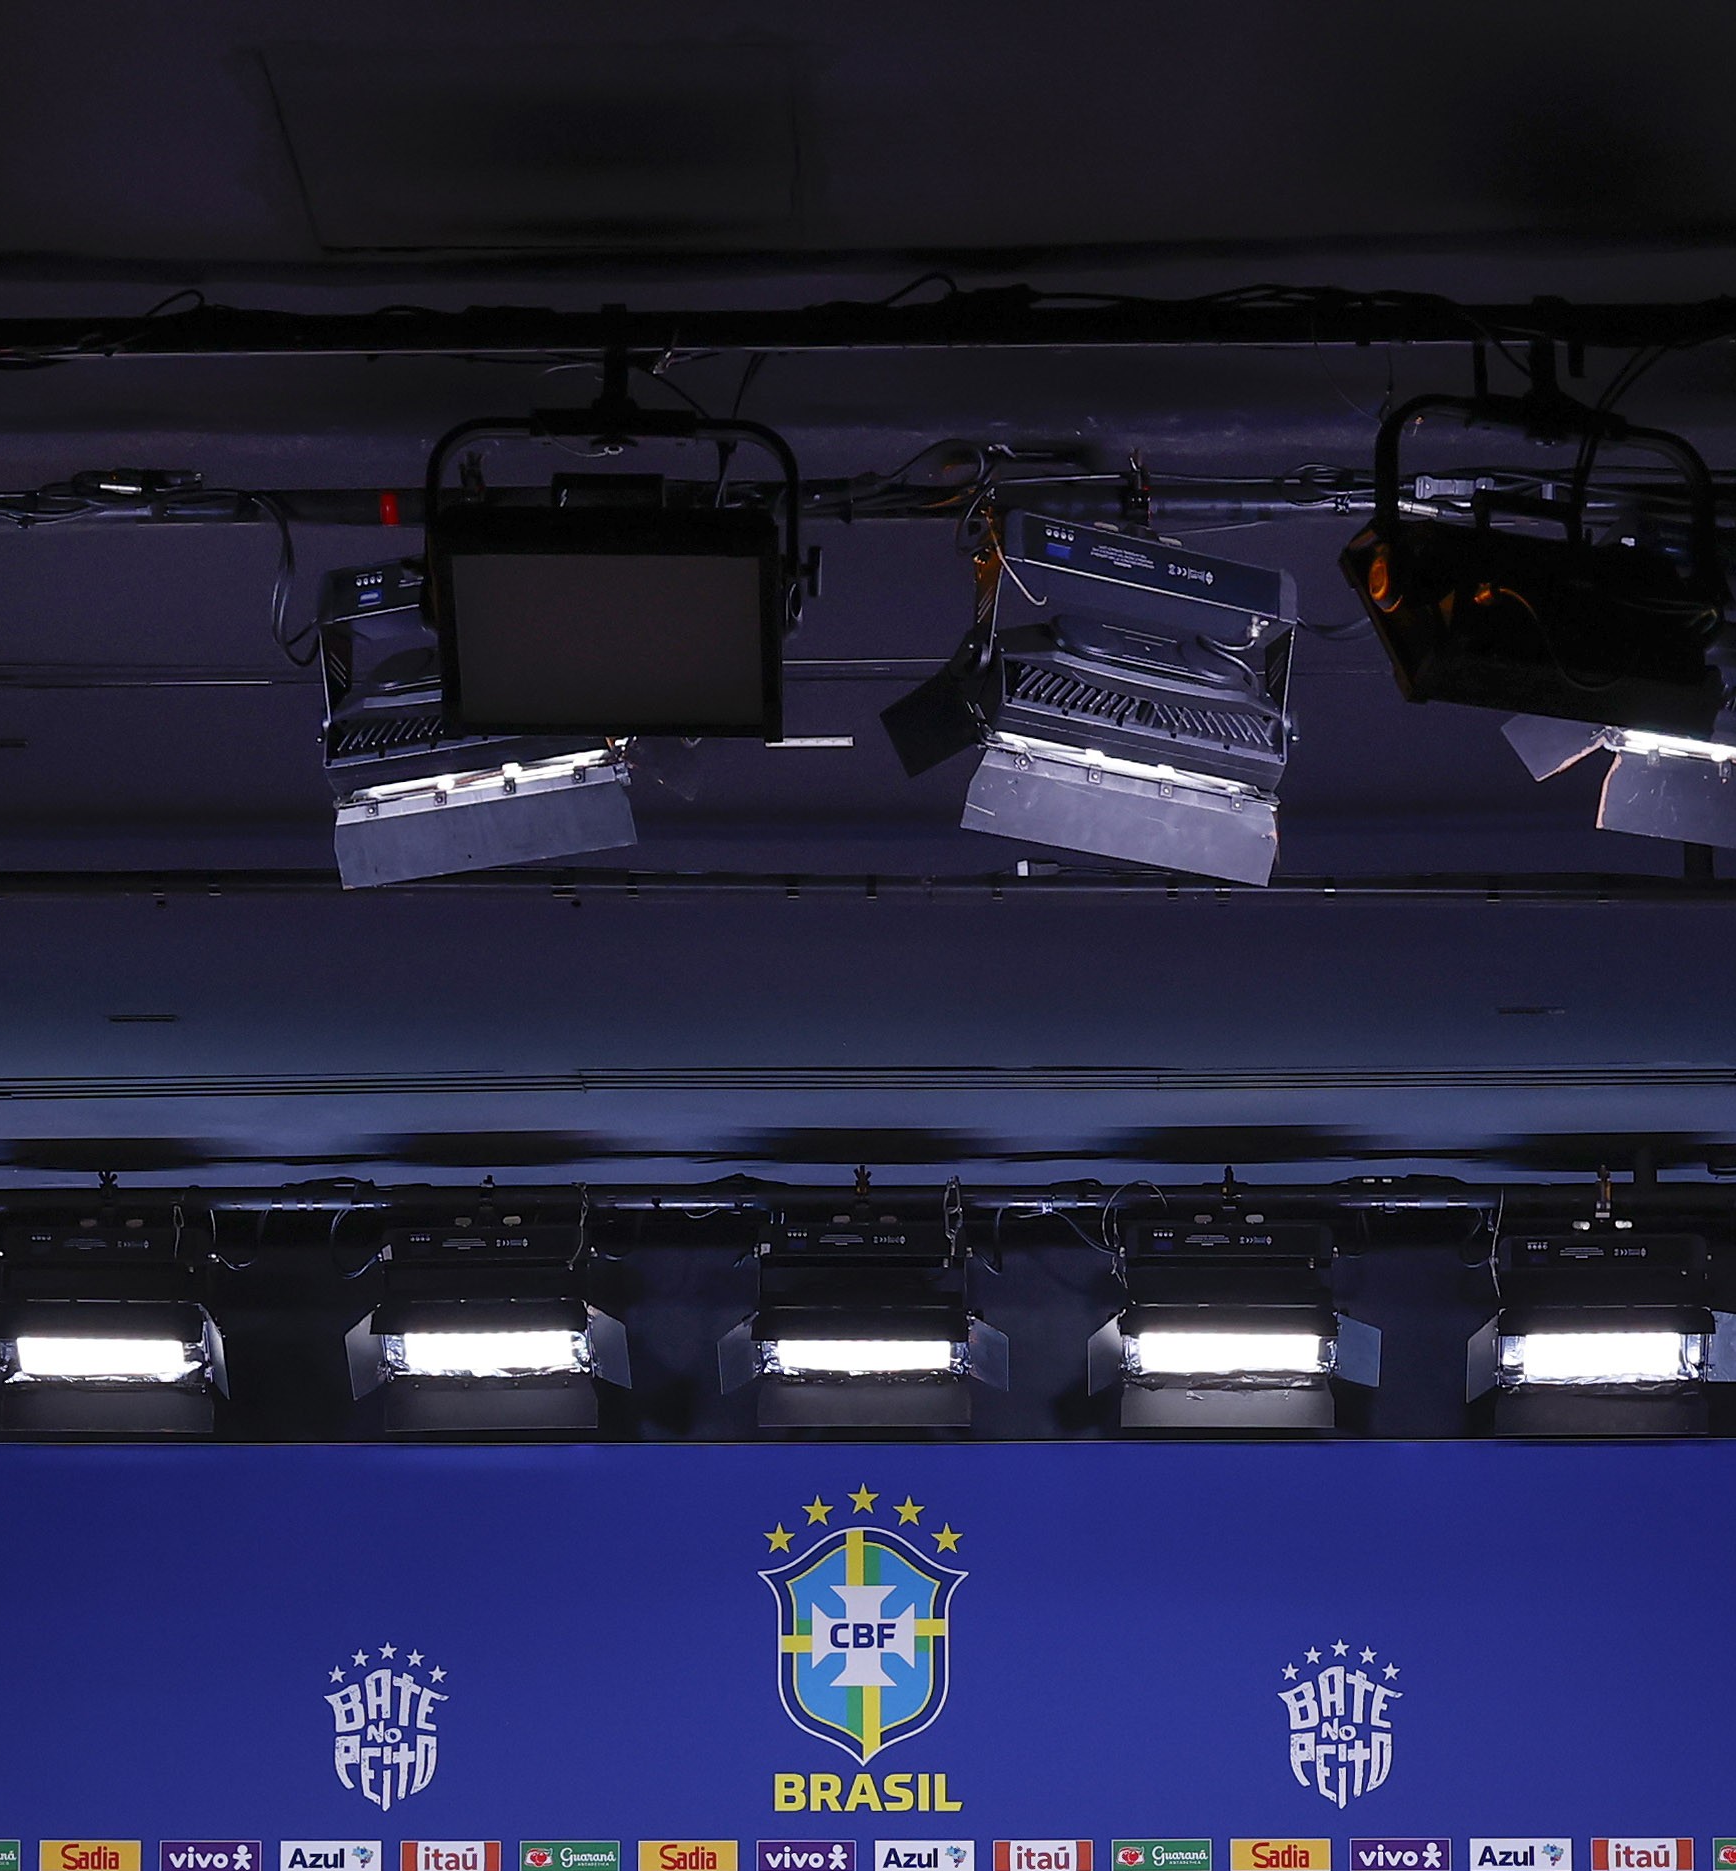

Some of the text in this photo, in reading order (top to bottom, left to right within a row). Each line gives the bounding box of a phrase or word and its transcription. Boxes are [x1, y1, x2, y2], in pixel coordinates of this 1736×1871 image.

[830, 1623, 896, 1648] CBF
[324, 1669, 449, 1732] BATE
[1277, 1666, 1403, 1730] BATE
[366, 1721, 402, 1743] NO
[1321, 1718, 1356, 1741] NO
[775, 1774, 962, 1811] BRASIL
[61, 1844, 119, 1870] Sadia
[169, 1847, 227, 1868] vivo
[289, 1848, 344, 1868] Azul
[425, 1847, 477, 1870] itaú
[560, 1844, 617, 1865] Guaraná
[660, 1844, 716, 1870] Sadia
[766, 1846, 824, 1868] vivo
[883, 1848, 938, 1868] Azul
[1017, 1846, 1069, 1869] itaú
[1153, 1844, 1210, 1865] Guaraná
[1252, 1842, 1309, 1868] Sadia
[1359, 1844, 1418, 1866] vivo
[1478, 1846, 1534, 1866] Azul
[1615, 1843, 1669, 1868] itaú
